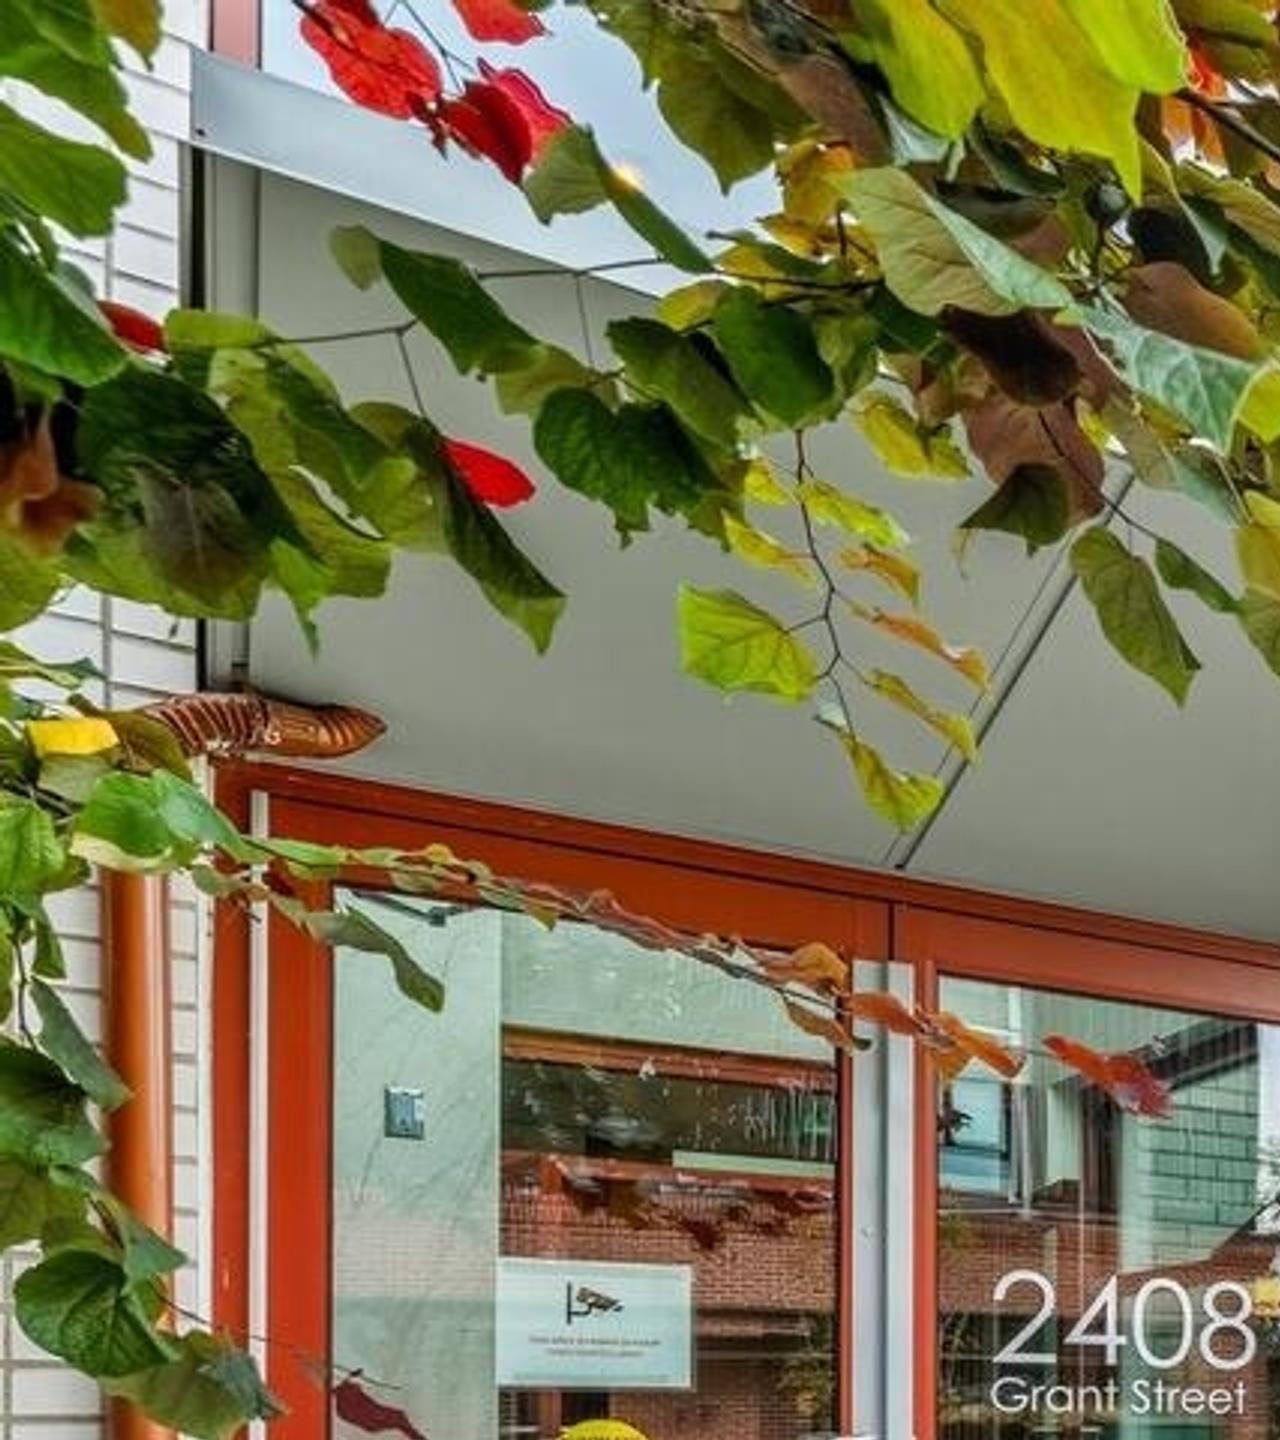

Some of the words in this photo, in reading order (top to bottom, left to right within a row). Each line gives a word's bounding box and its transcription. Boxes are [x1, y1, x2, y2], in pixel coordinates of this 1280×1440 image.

[993, 1269, 1257, 1371] 2408
[991, 1376, 1118, 1413] Grant
[1131, 1379, 1247, 1415] Street
